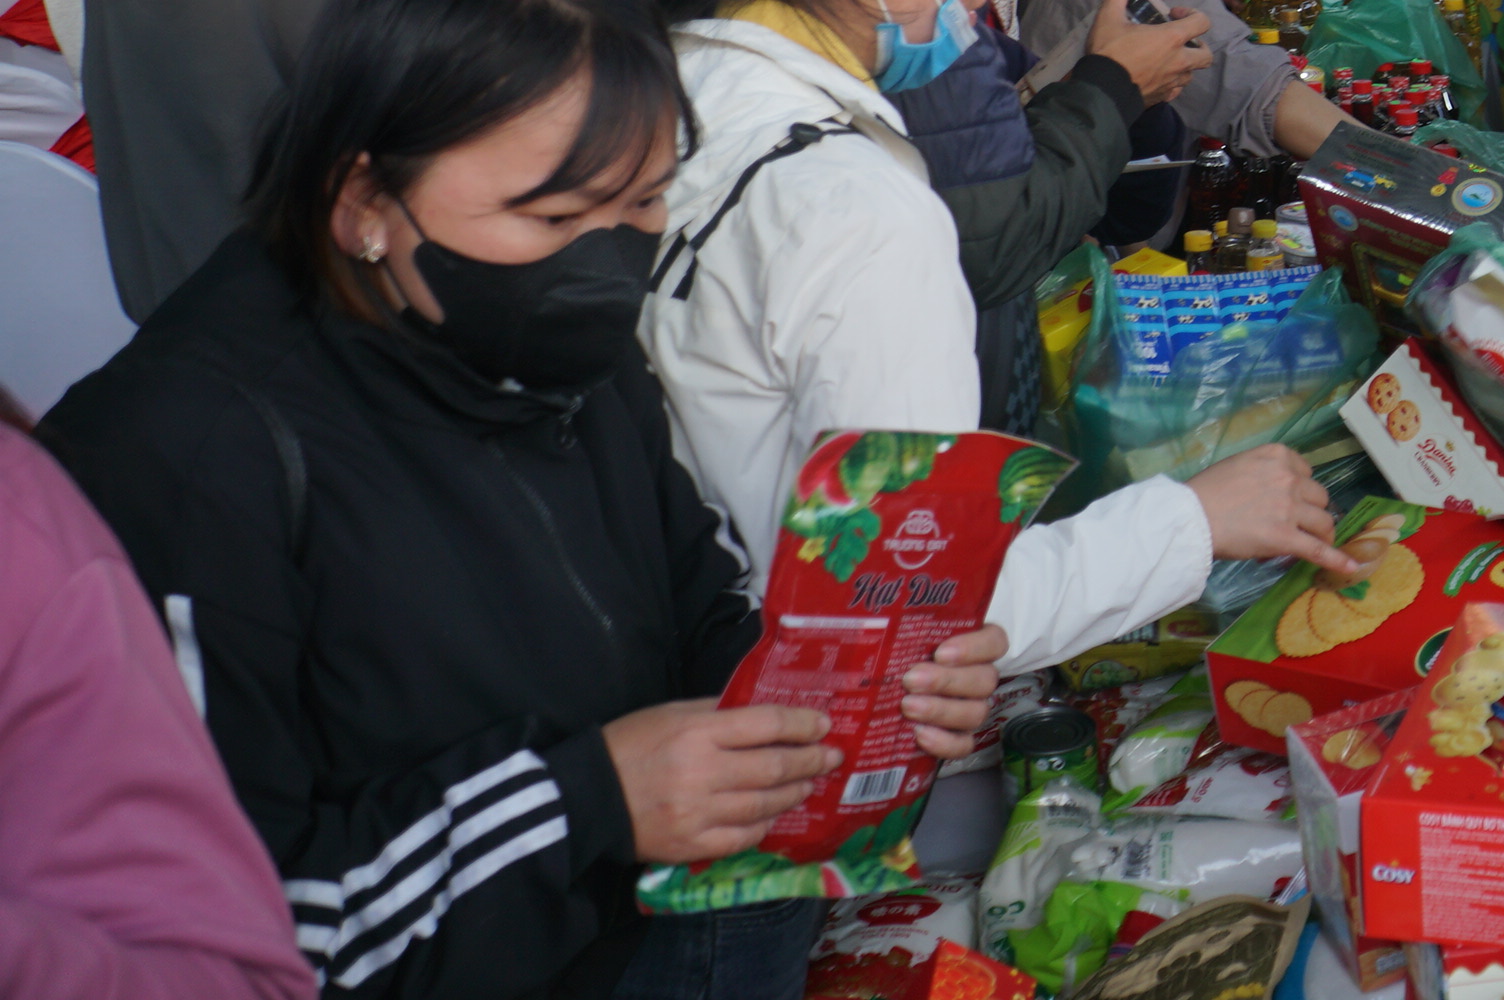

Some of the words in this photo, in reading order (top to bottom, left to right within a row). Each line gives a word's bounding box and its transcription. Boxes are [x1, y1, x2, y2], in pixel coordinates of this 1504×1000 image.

[1414, 451, 1441, 487] CRANBERRY
[1416, 438, 1457, 478] Danisa
[1372, 863, 1415, 884] COSY
